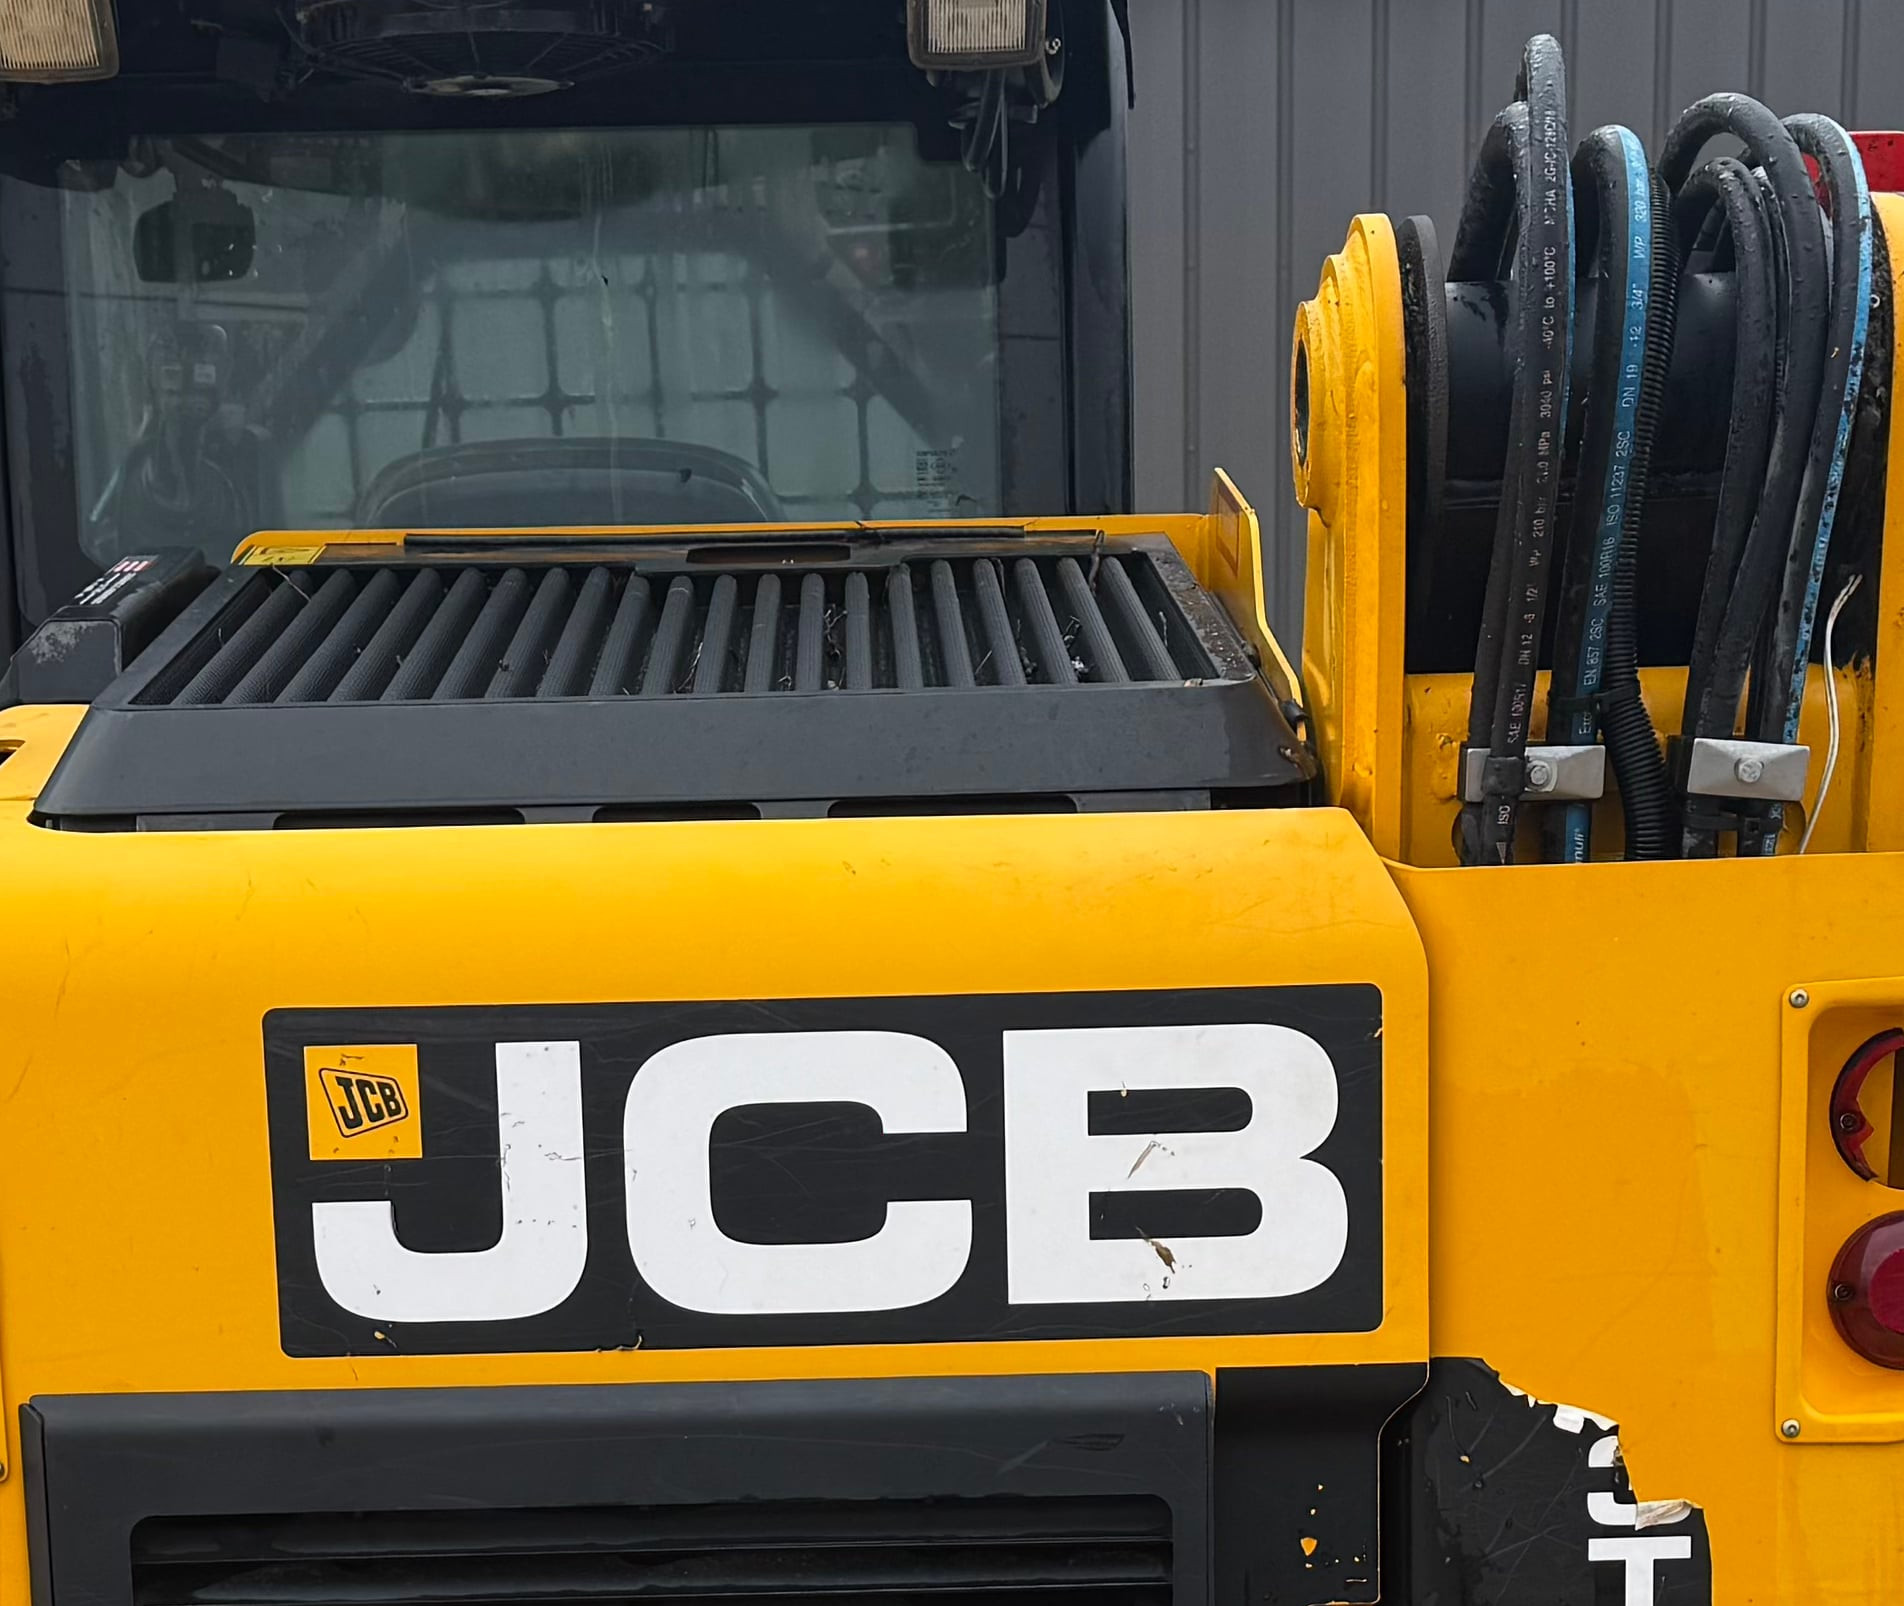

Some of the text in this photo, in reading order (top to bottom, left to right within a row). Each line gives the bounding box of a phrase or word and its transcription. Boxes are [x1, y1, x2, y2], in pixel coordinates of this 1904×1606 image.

[1632, 235, 1646, 259] WP
[1625, 363, 1638, 379] 19
[1621, 386, 1636, 408] DN
[1615, 430, 1631, 458] 2SC
[1609, 464, 1625, 499] 11237
[1605, 504, 1621, 526] ISO
[1496, 805, 1511, 825] ISO
[1520, 633, 1534, 646] 12
[1543, 296, 1556, 309] to
[1598, 536, 1616, 579] 100R16
[1593, 583, 1608, 607] SAE
[1589, 618, 1604, 641] 2SC
[1585, 646, 1600, 666] 857
[1583, 668, 1597, 686] EN
[335, 1076, 402, 1130] JCB
[311, 1022, 1349, 1323] JCB
